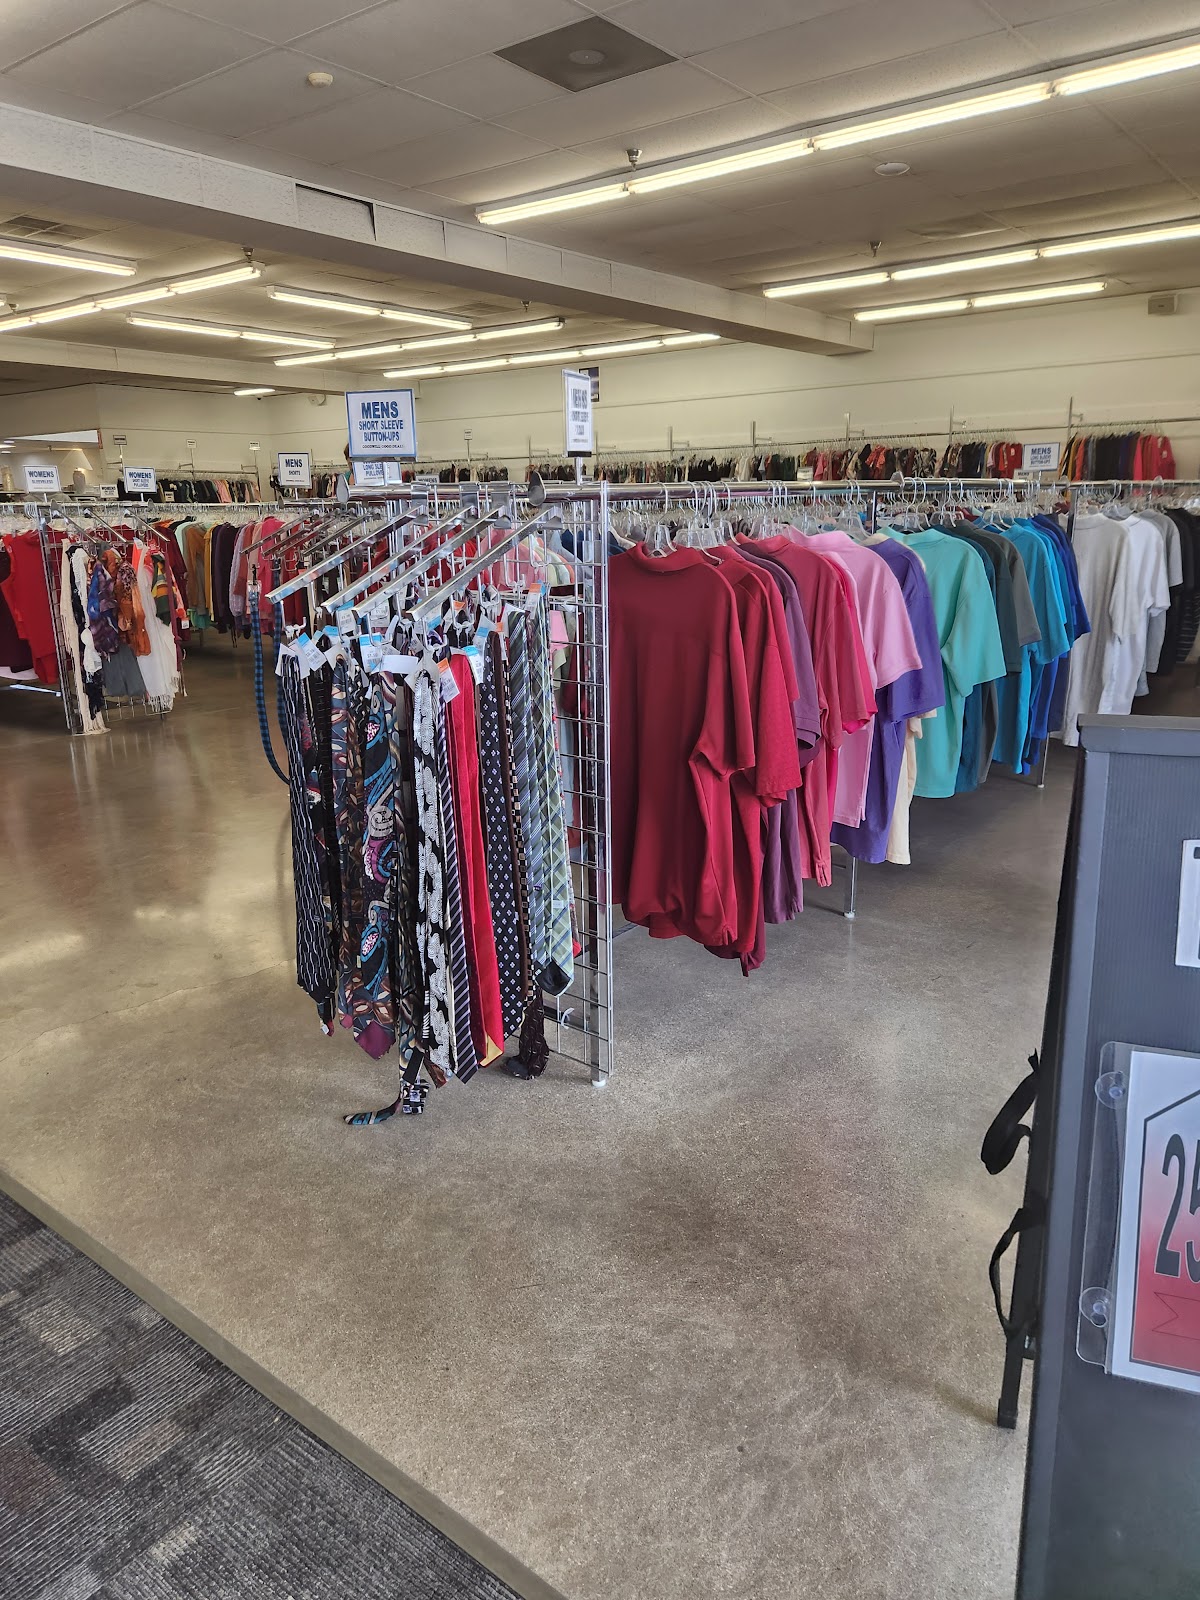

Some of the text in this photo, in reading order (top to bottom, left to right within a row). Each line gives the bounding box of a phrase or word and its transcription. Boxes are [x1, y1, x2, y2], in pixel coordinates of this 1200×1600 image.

[361, 401, 399, 419] MENS
[358, 420, 404, 431] SHORT SLEEVE
[363, 431, 400, 442] BUTTON-UPS
[1031, 447, 1052, 455] MENS
[285, 459, 302, 467] MENS
[27, 470, 55, 478] WOMENS
[128, 471, 152, 479] WOMENS
